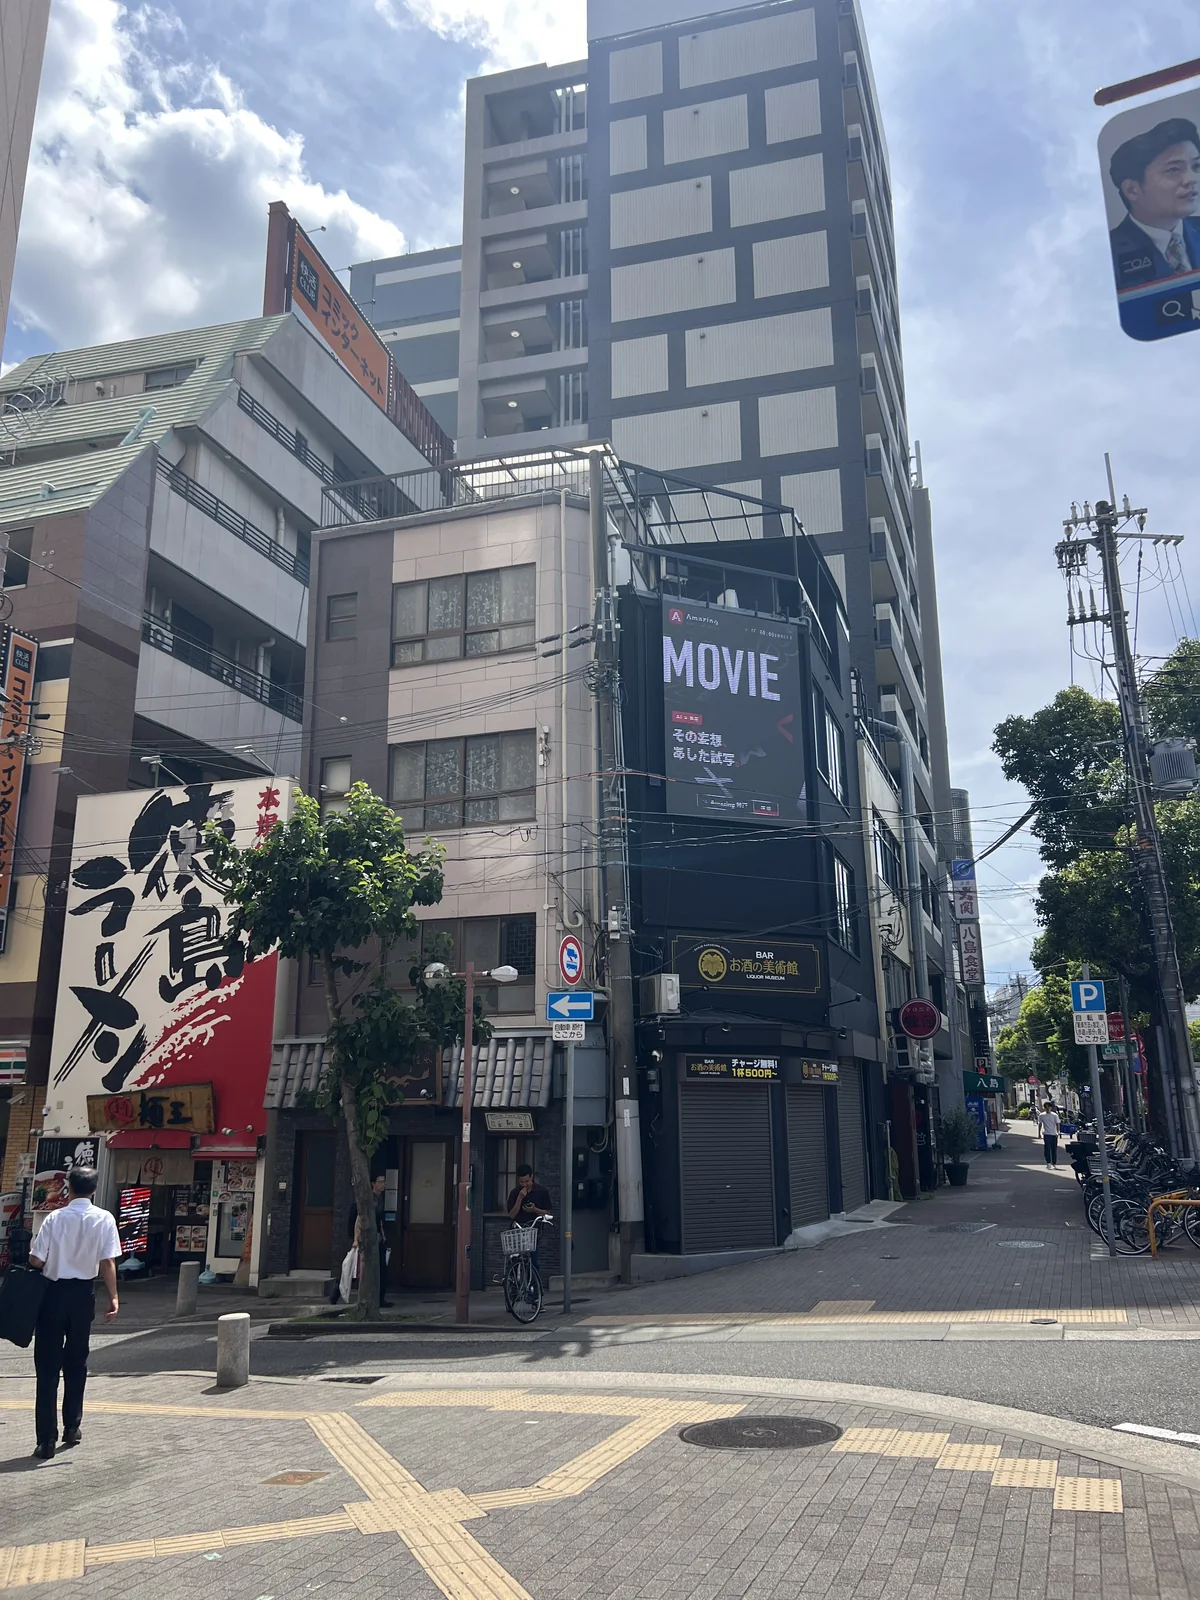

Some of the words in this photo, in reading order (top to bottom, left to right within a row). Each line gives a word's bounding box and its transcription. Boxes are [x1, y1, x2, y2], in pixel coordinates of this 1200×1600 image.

[300, 276, 316, 302] CLUB
[322, 284, 359, 340] コミック
[321, 309, 384, 395] インターネット
[663, 636, 781, 701] MOVIE
[255, 786, 281, 850] 本場
[729, 958, 799, 975] お酒の美術館
[755, 951, 774, 960] BAR
[963, 927, 980, 982] 八島食堂
[53, 855, 157, 1093] ラーメン
[1079, 984, 1098, 1009] P
[732, 1058, 777, 1069] チャージ無料!
[976, 1077, 998, 1088] 八島
[75, 1141, 95, 1168] 徳
